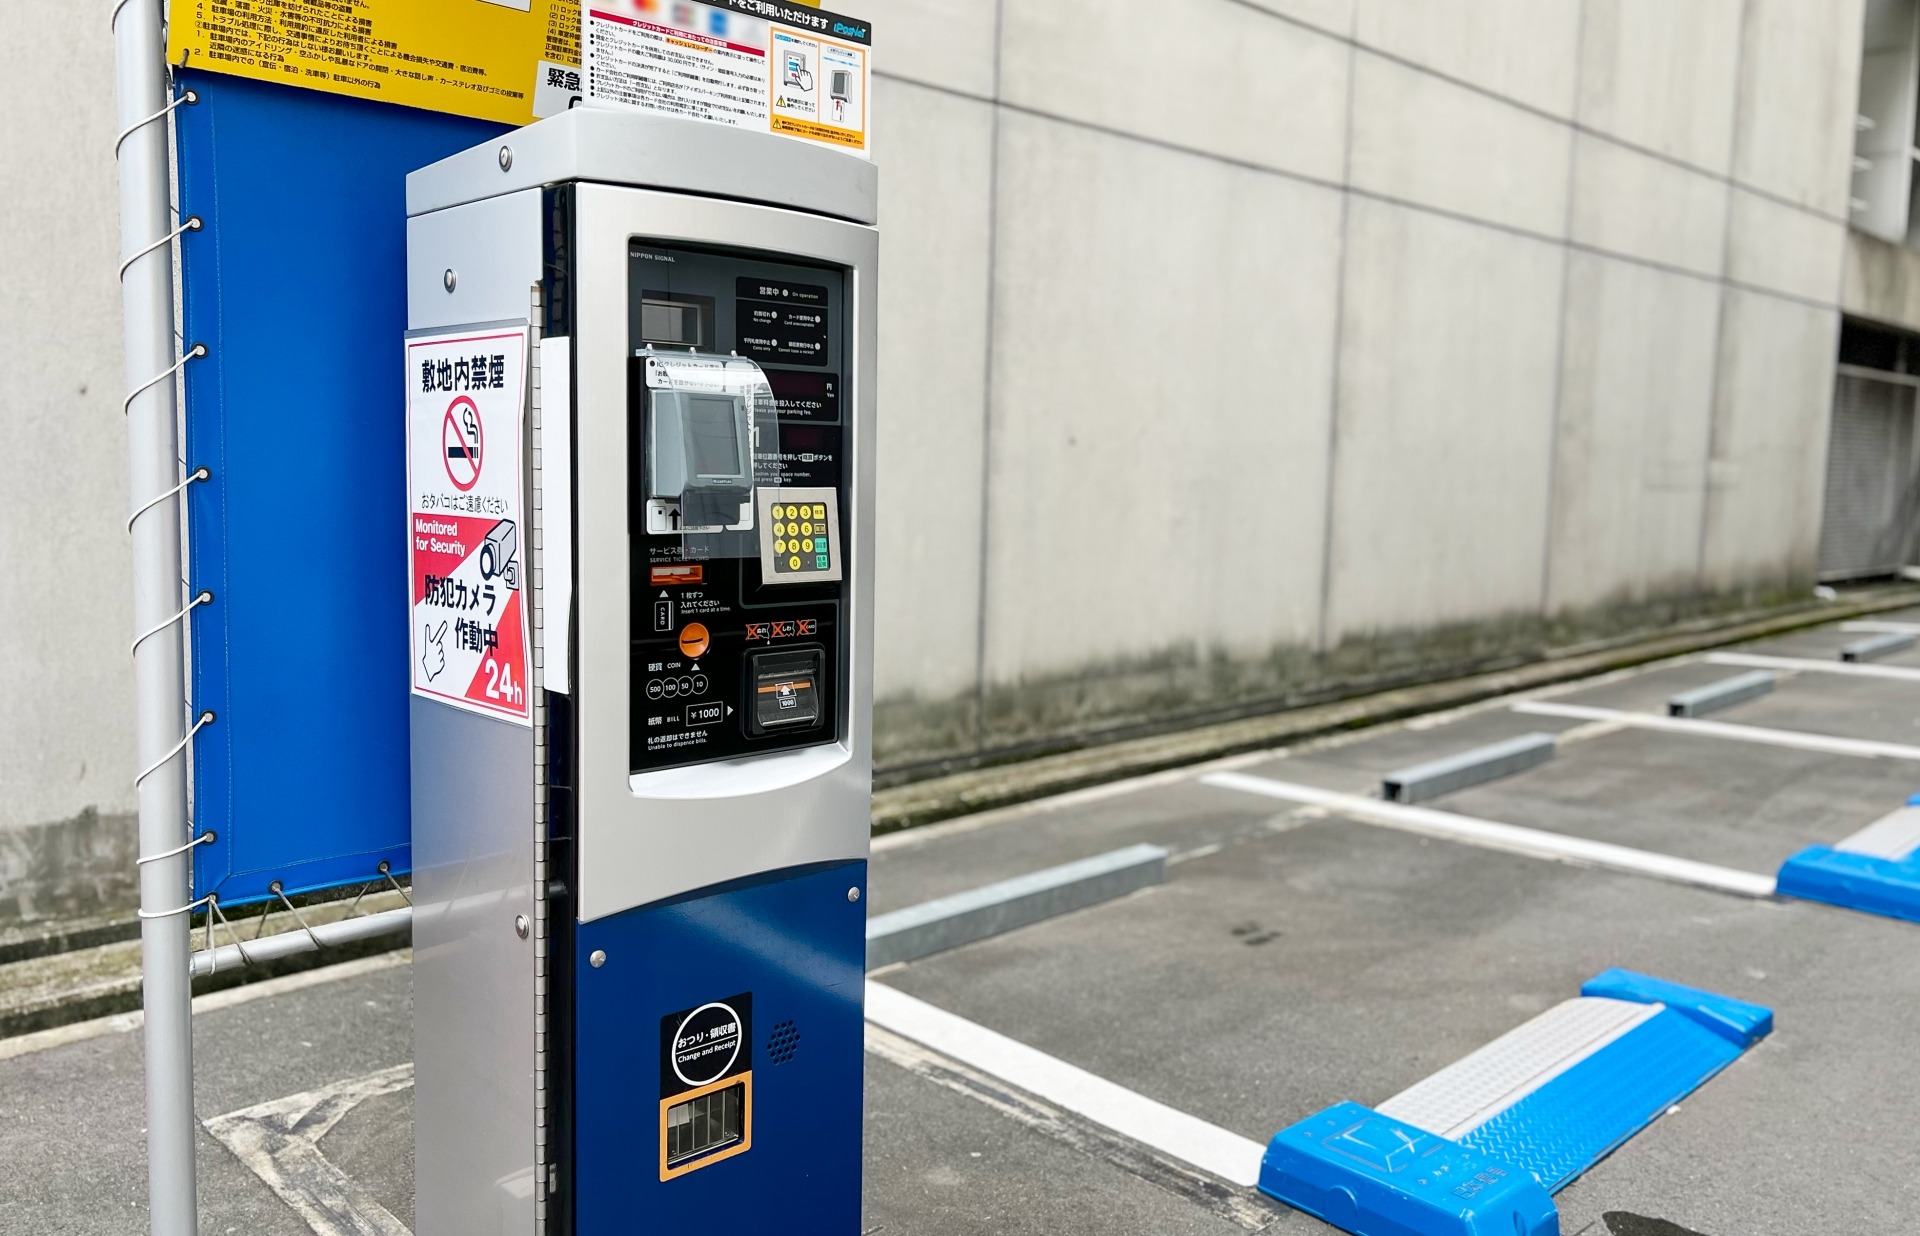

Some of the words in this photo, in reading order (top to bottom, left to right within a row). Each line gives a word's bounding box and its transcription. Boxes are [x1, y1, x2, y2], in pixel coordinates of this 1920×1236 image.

[209, 41, 285, 63] 近隣の迷惑になる行為
[547, 67, 582, 92] 緊急
[630, 251, 653, 260] NIPPON
[654, 254, 676, 263] SIGNAL
[759, 286, 780, 296] 営業中
[422, 354, 505, 393] 敷地内禁煙
[421, 492, 508, 515] おタバコはご遠慮ください
[790, 509, 795, 517] 2
[803, 509, 808, 517] 3
[416, 519, 458, 536] Monitored
[777, 525, 782, 533] 4
[790, 525, 796, 534] 5
[804, 525, 810, 534] 6
[416, 536, 429, 550] for
[430, 537, 466, 558] Security
[777, 542, 783, 551] 7
[791, 542, 797, 551] 8
[805, 541, 810, 550] 9
[792, 559, 798, 568] 0
[424, 574, 496, 616] 防犯カメラ
[680, 600, 720, 609] 入れてください
[454, 617, 499, 657] 作動中
[485, 658, 523, 706] 24h
[649, 685, 661, 693] 500
[681, 682, 689, 690] 50
[696, 680, 704, 688] 10
[781, 699, 794, 707] 1000
[666, 715, 680, 723] BILL
[647, 730, 708, 745] 札の返却はできません
[678, 1022, 736, 1049] おつり・領収書
[678, 1052, 701, 1063] Change
[702, 1046, 714, 1056] and
[714, 1040, 736, 1052] Receipt
